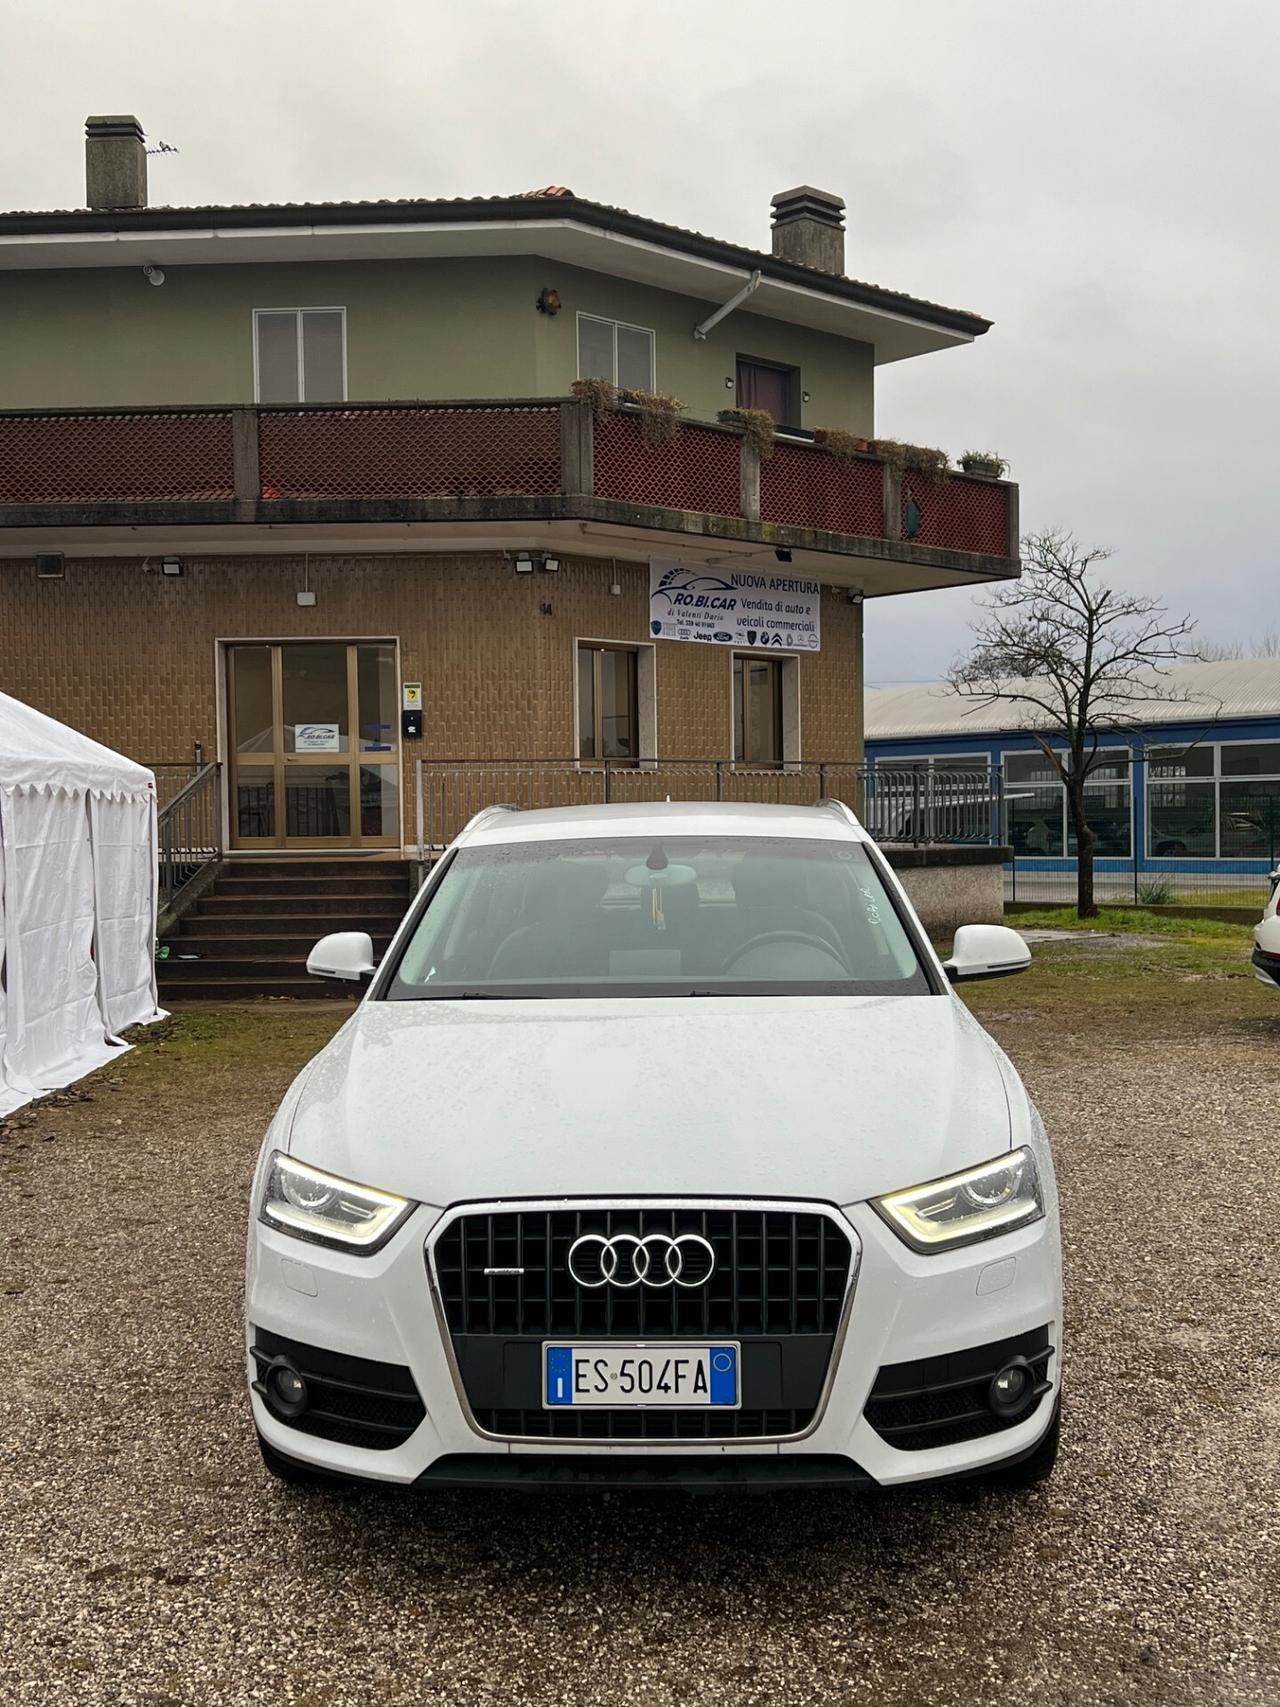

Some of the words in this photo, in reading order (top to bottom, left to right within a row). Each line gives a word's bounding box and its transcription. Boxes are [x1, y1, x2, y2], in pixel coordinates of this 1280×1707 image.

[730, 573, 767, 589] NUOVA
[769, 577, 819, 595] APERTURA
[673, 593, 737, 611] RO.BI.CAR
[740, 599, 773, 611] Vendita
[775, 600, 783, 612] di
[785, 603, 804, 614] auto
[805, 606, 811, 615] e
[667, 608, 675, 616] di
[704, 611, 724, 621] Dario
[736, 616, 764, 628] veicoli
[766, 619, 815, 632] commerciali
[694, 631, 712, 642] Jeep
[575, 1358, 609, 1394] ES
[619, 1358, 708, 1394] 504FA
